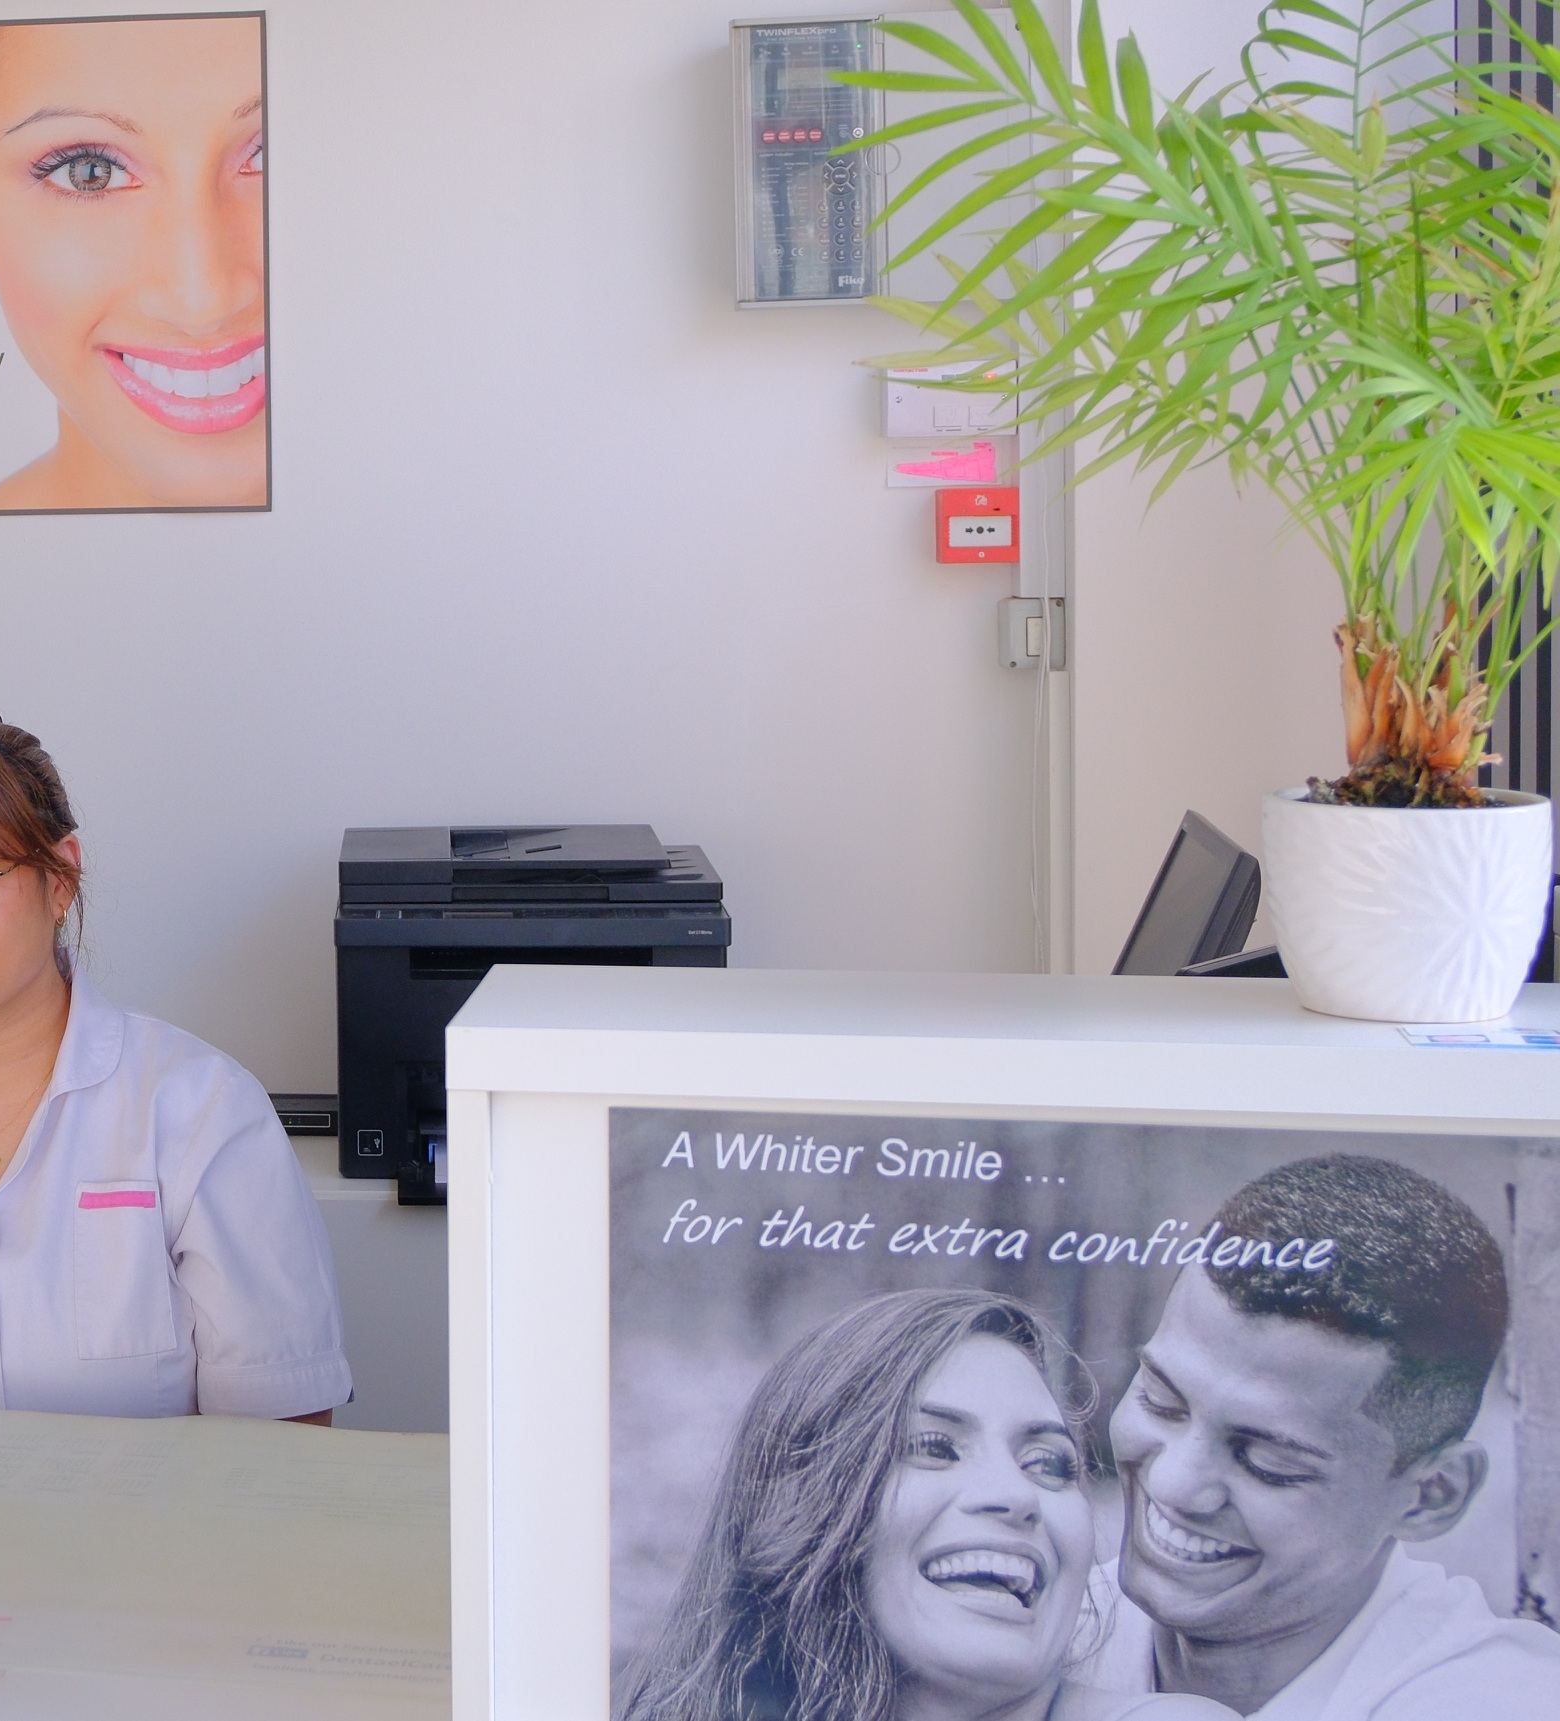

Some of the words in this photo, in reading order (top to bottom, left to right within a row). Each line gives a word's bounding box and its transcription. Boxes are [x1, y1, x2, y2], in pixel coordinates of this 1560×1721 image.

[662, 1131, 695, 1168] A
[715, 1132, 865, 1175] Whiter
[876, 1137, 1003, 1182] Smile
[662, 1198, 743, 1245] for
[758, 1204, 875, 1252] that
[887, 1217, 1030, 1262] extra
[1047, 1218, 1337, 1271] confidence
